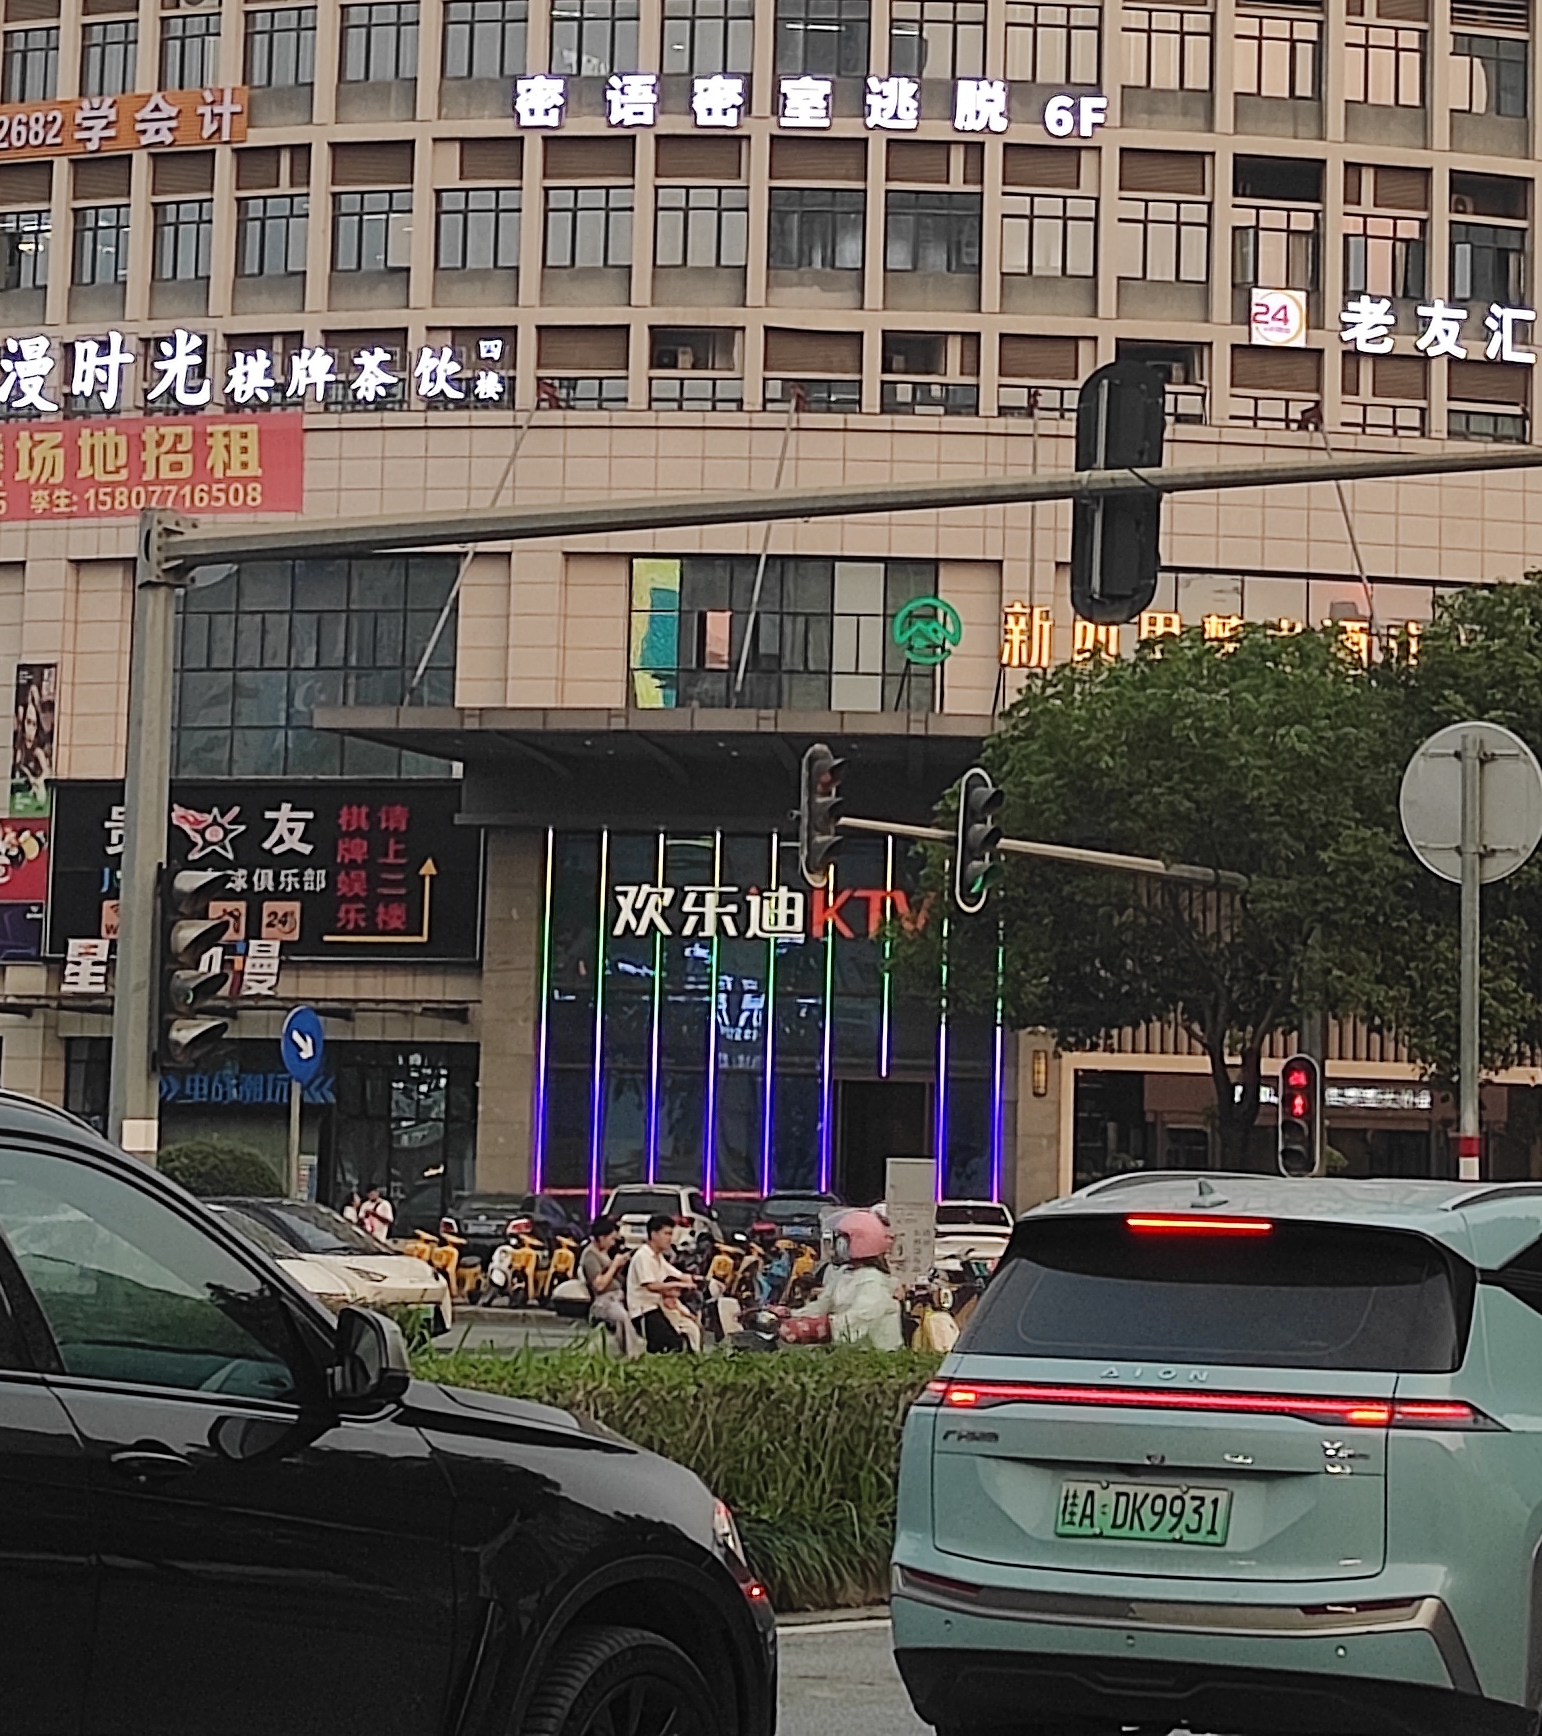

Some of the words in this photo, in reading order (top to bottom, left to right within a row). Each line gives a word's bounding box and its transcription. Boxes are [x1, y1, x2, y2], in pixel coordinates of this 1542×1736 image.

[74, 88, 244, 152] 学会计
[515, 74, 1009, 134] 密语密室逃脱
[1044, 96, 1108, 137] 6F
[1252, 302, 1290, 326] 24
[1099, 1365, 1209, 1383] AION
